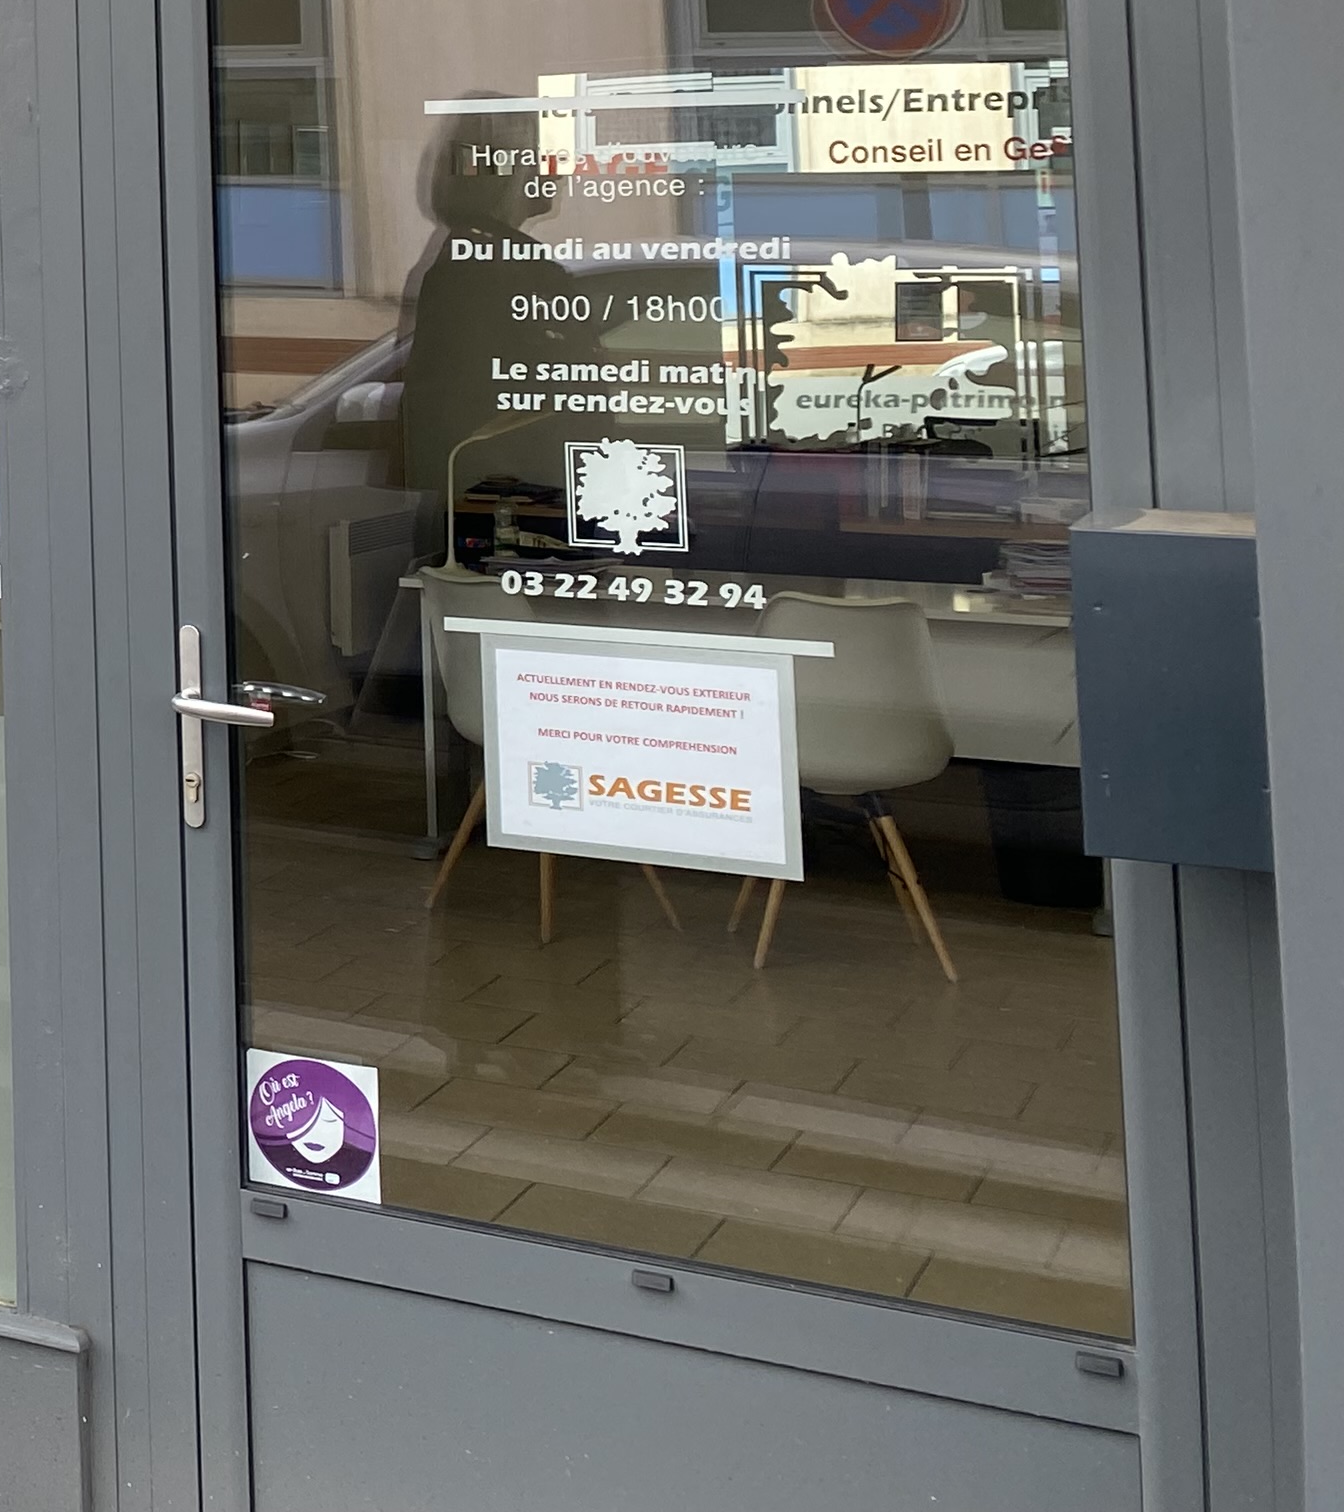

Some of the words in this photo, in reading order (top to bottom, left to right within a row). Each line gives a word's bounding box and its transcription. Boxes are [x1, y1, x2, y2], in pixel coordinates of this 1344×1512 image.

[829, 139, 943, 165] Conseil
[955, 142, 991, 162] en
[524, 175, 557, 199] de
[568, 175, 686, 203] l'agence
[450, 238, 494, 262] Du
[500, 237, 584, 263] lundi
[592, 242, 633, 262] au
[640, 237, 792, 261] vendredi
[510, 293, 594, 325] 9h00
[602, 294, 614, 323] /
[624, 293, 725, 323] 18h00
[491, 357, 530, 383] Le
[536, 358, 650, 386] samedi
[657, 359, 757, 386] matin
[496, 390, 546, 414] sur
[552, 387, 753, 417] rendez-vous
[500, 570, 546, 598] 03
[552, 571, 600, 601] 22
[607, 574, 655, 604] 49
[662, 578, 712, 607] 32
[718, 581, 767, 610] 94
[517, 673, 596, 689] ACTUELLEMENT
[599, 680, 613, 690] EN
[616, 680, 690, 697] RENDEZ-VOUS
[693, 688, 751, 702] EXTERIEUR
[529, 692, 559, 703] NOUS
[561, 694, 602, 707] SERONS
[604, 698, 619, 708] DE
[621, 699, 663, 712] RETOUR
[666, 703, 737, 719] RAPIDEMENT
[538, 728, 571, 740] MERCI
[573, 731, 603, 743] POUR
[606, 734, 640, 746] VOTRE
[642, 737, 737, 756] COMPREHENSION
[588, 774, 752, 813] SAGESSE
[259, 1077, 281, 1106] Où
[282, 1073, 300, 1089] est
[265, 1093, 307, 1129] Angela
